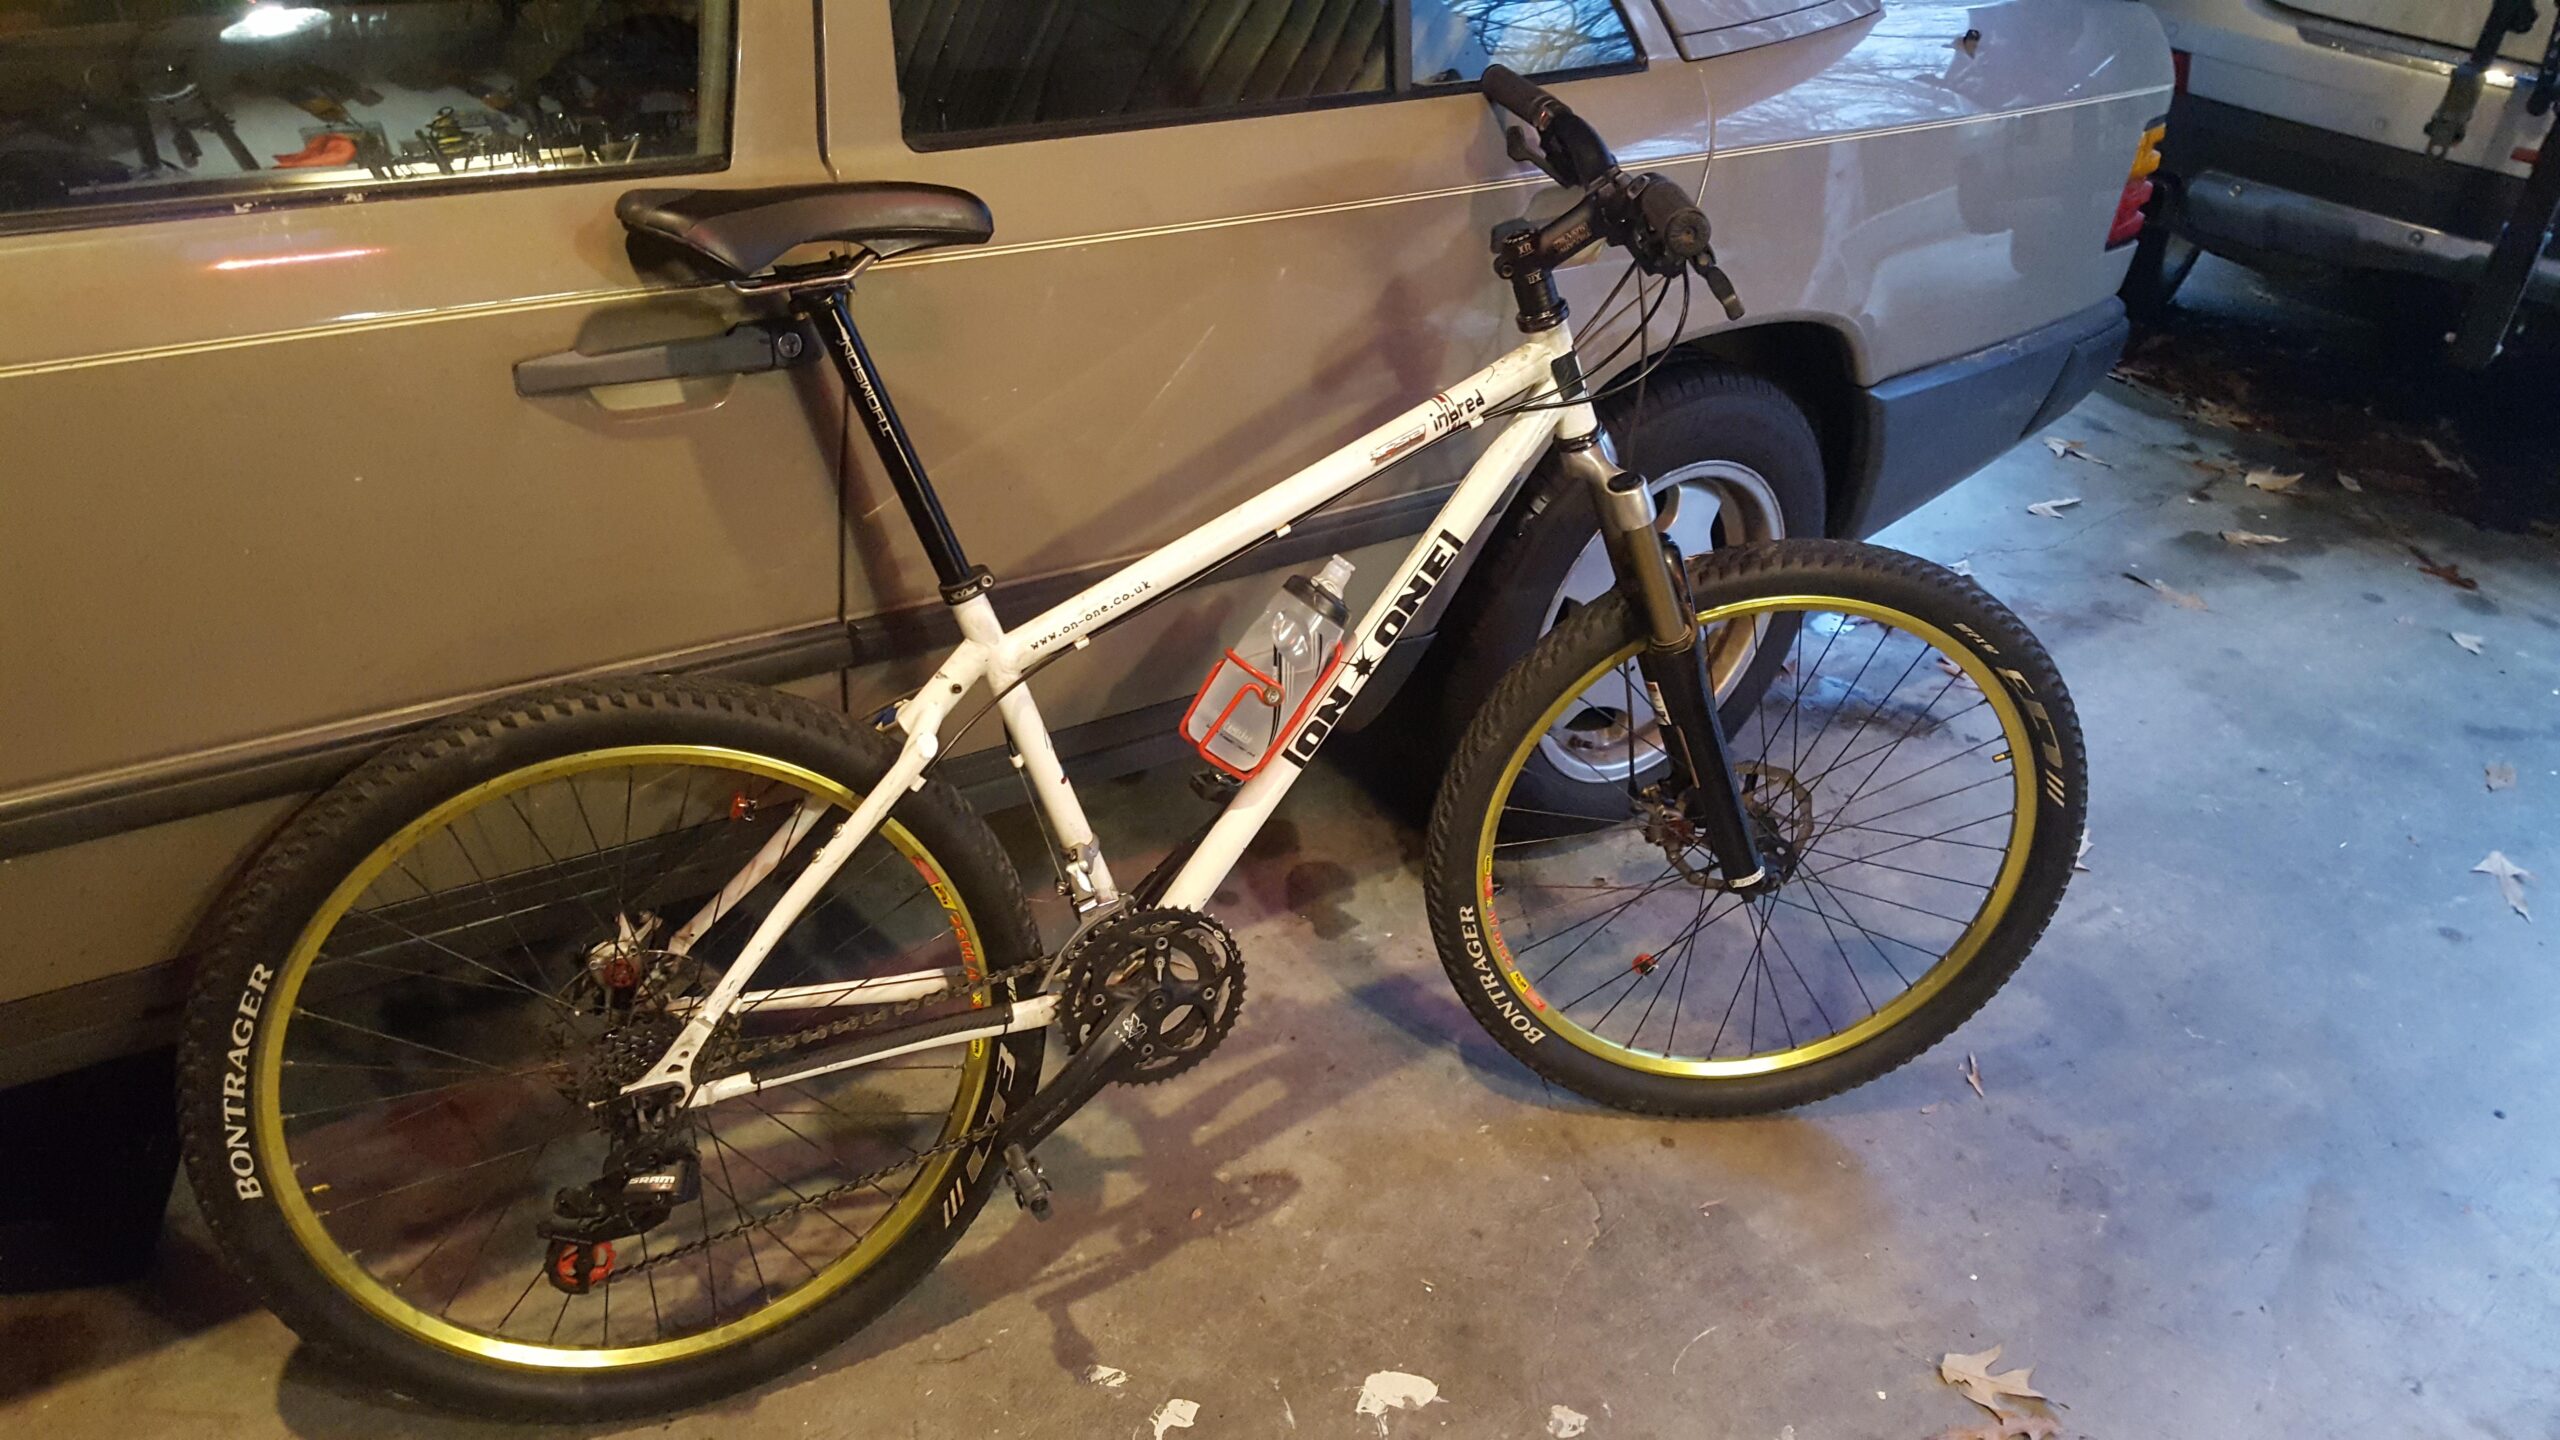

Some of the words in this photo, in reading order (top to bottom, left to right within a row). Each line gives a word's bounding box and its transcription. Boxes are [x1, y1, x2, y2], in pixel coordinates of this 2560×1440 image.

[1429, 388, 1486, 432] inbred
[1029, 580, 1153, 652] www.on-one.co.uk
[1294, 684, 1353, 758] ON
[1374, 545, 1456, 647] ONE
[1458, 904, 1547, 1045] BONTRAGER
[222, 962, 275, 1201] BONTRAGER
[628, 1175, 676, 1186] SRAM
